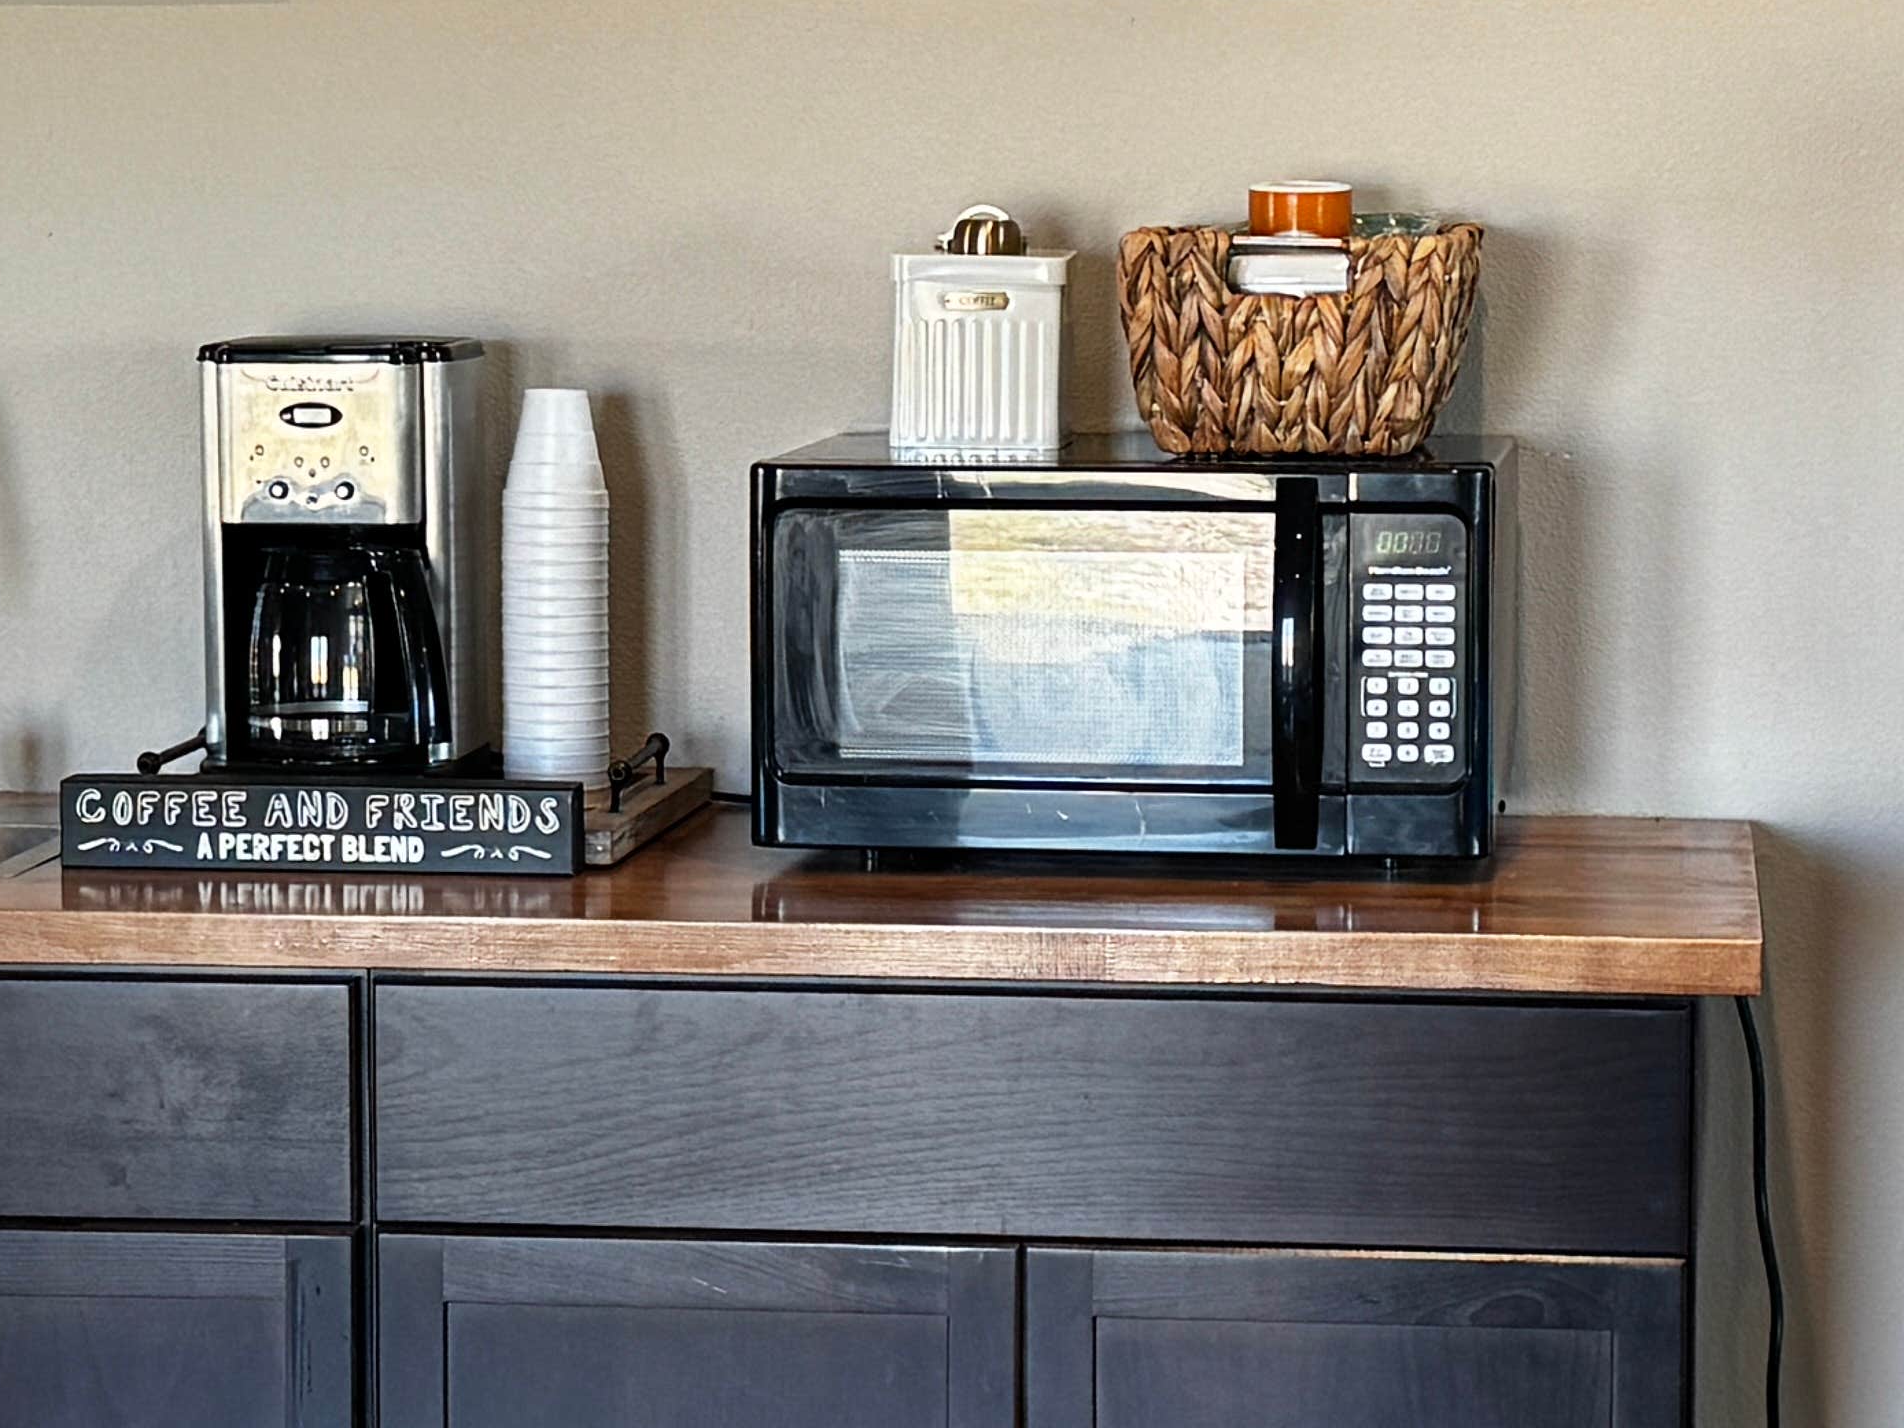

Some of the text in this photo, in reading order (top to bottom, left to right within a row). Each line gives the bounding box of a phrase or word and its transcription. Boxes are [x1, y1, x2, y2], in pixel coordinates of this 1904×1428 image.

[75, 787, 561, 835] COFFEE AND FRIENDS
[196, 831, 426, 864] A PERFECT BLEND
